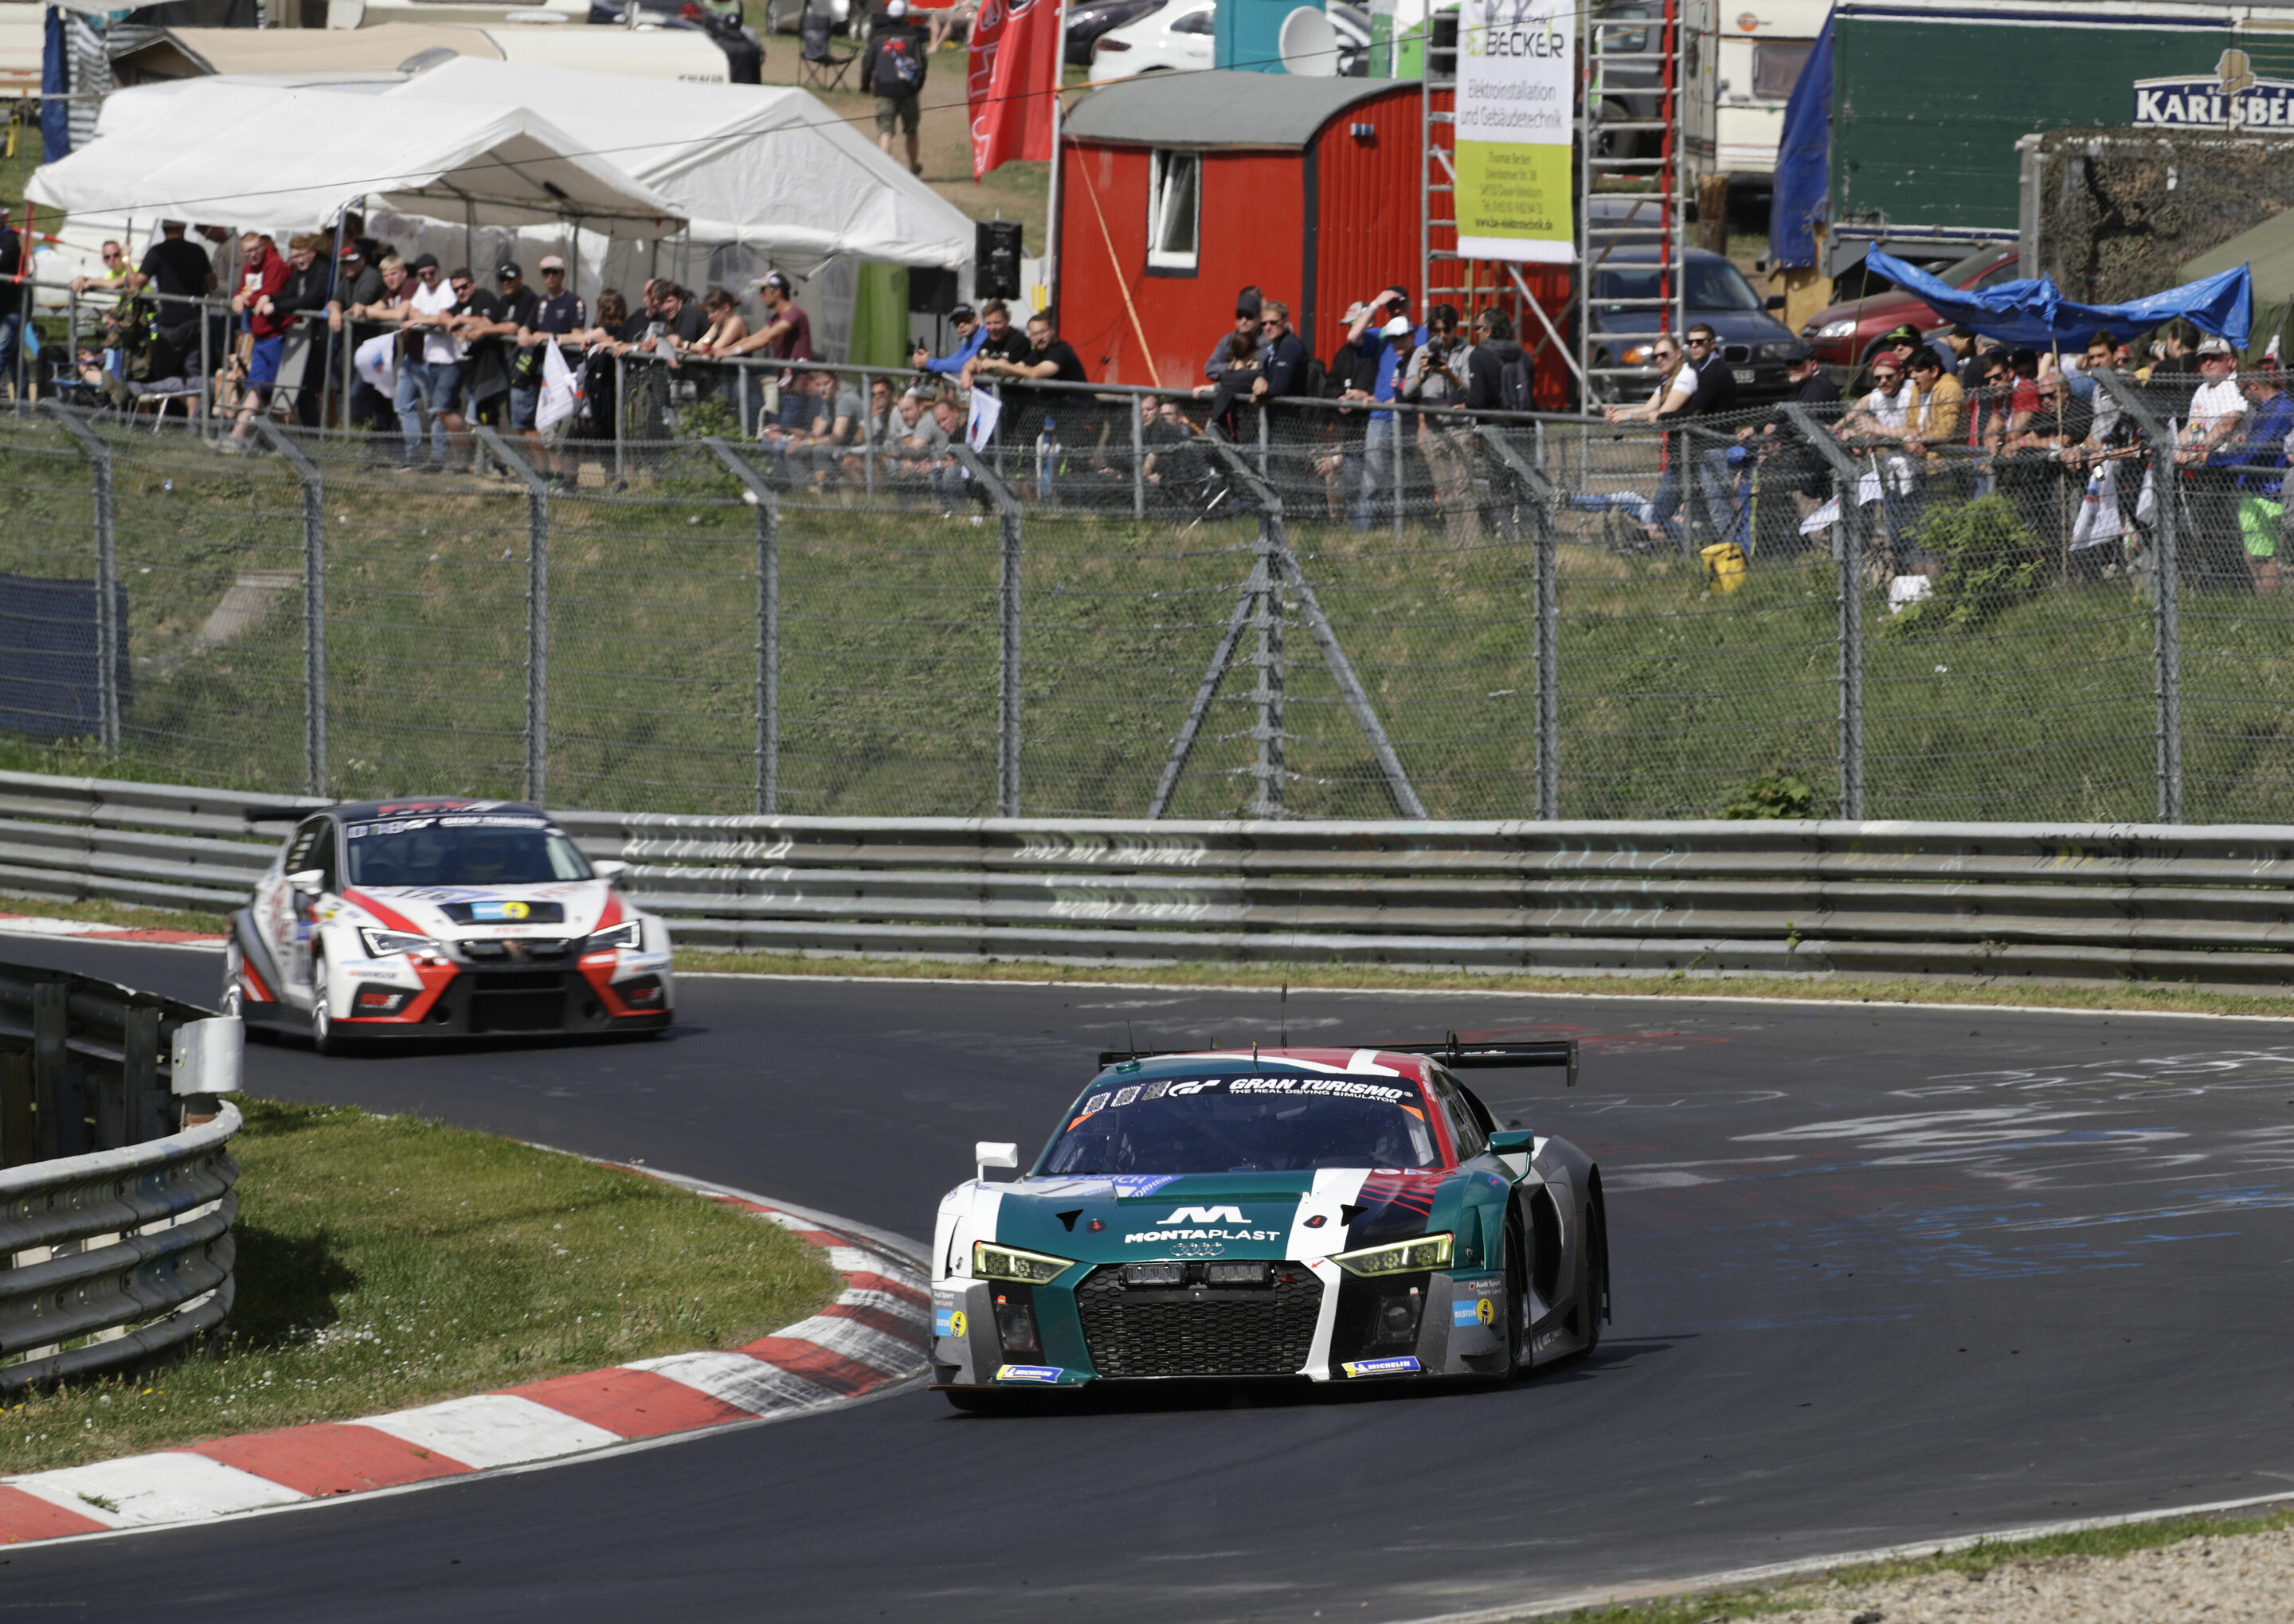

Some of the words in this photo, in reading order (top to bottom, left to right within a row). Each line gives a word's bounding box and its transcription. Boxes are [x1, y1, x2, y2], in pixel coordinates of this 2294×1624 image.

[1486, 32, 1564, 58] BECKER
[1467, 79, 1556, 101] Elektroinstallation
[1461, 108, 1479, 125] und
[1482, 108, 1562, 128] Gebäudetechnik
[1229, 1078, 1297, 1090] GRAN
[1301, 1079, 1403, 1099] TURISMO
[1333, 1091, 1397, 1104] SIMULATOR
[1125, 1230, 1280, 1243] MONTAPLAST
[1454, 1309, 1477, 1318] BILSTEIN
[1368, 1360, 1411, 1369] MICHELIN
